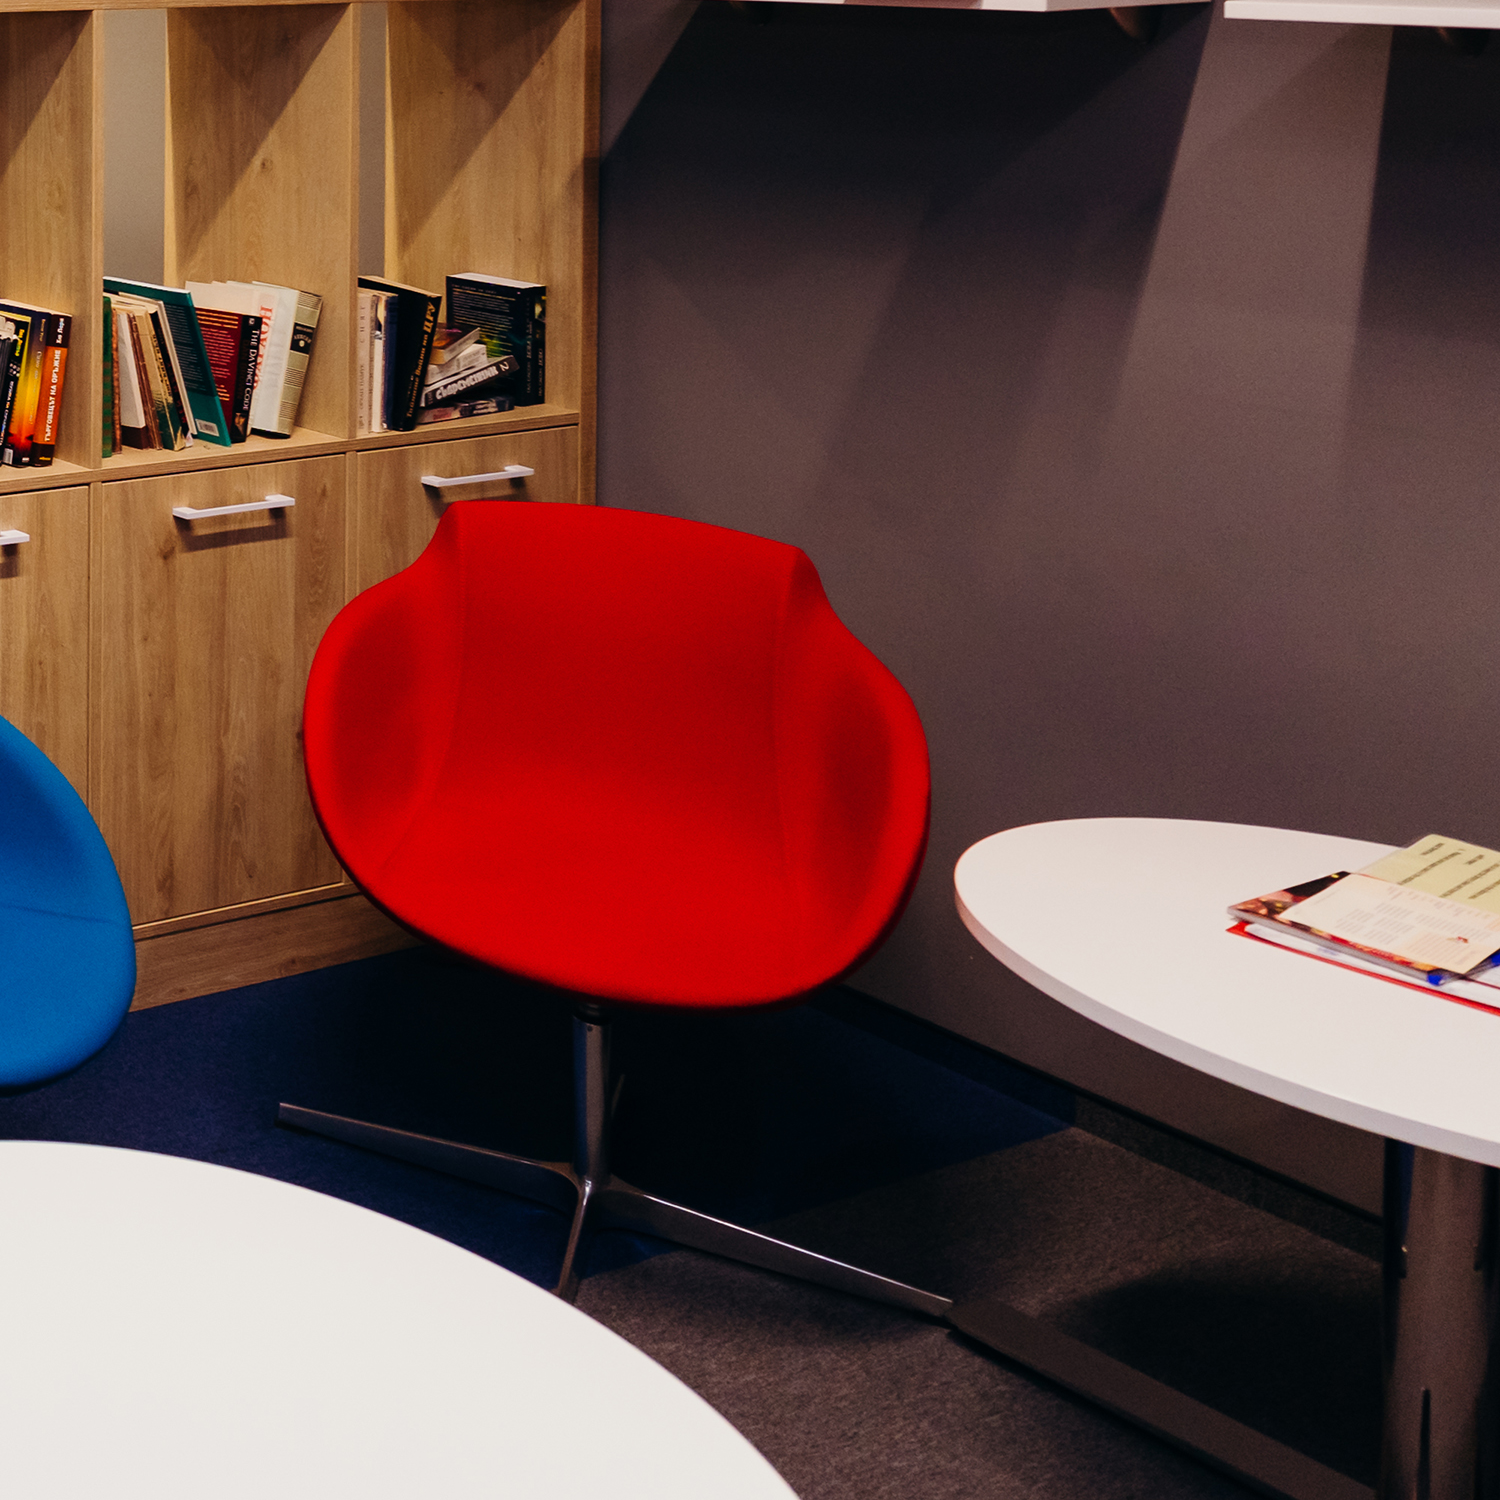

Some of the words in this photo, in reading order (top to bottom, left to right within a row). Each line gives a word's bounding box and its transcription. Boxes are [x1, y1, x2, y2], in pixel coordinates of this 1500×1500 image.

[55, 316, 66, 334] Лори
[421, 300, 437, 333] ЦРУ
[54, 333, 64, 344] Хю
[250, 328, 260, 346] THE
[420, 333, 428, 346] на
[248, 348, 257, 361] DA
[50, 348, 62, 383] ОРЪЖИЕ
[245, 361, 255, 386] VINCI
[48, 383, 57, 395] НА
[242, 386, 252, 411] CODE
[42, 396, 57, 441] ТЪРГОВЕЦЪТ
